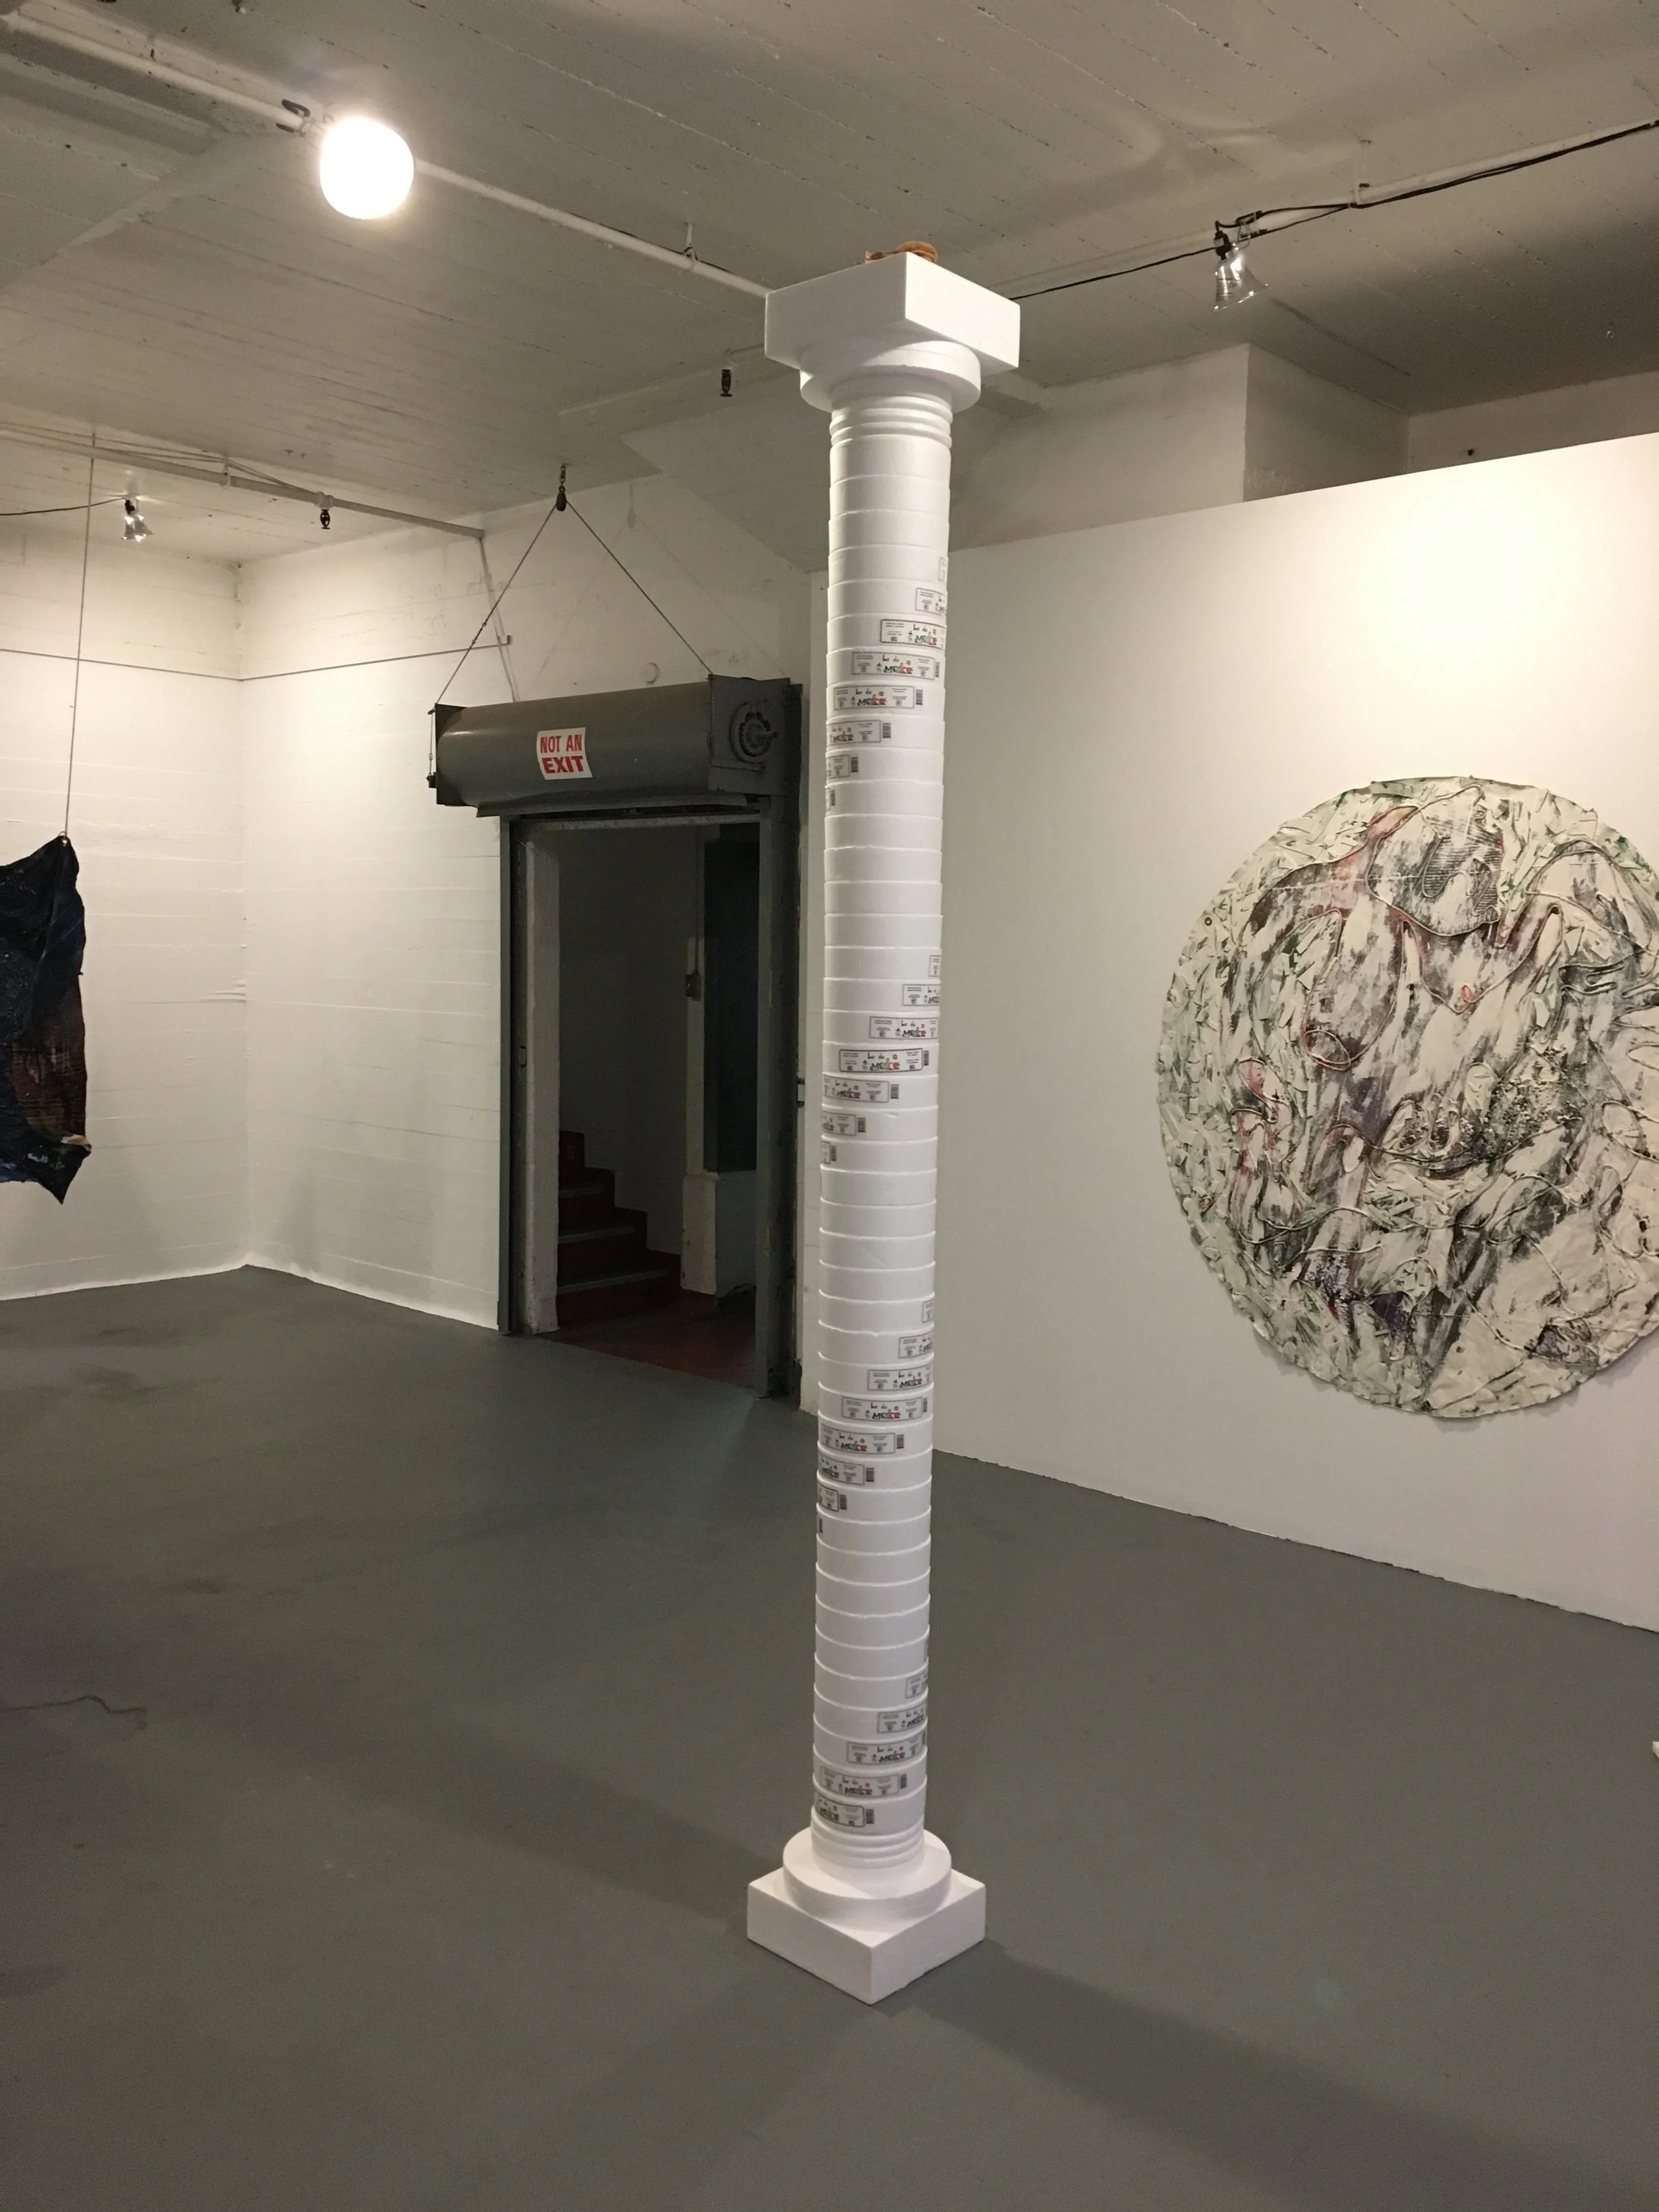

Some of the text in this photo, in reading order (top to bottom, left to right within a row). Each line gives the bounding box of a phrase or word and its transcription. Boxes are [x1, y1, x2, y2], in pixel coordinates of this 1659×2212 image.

[540, 734, 582, 753] NOT AN
[541, 755, 584, 774] EXIT
